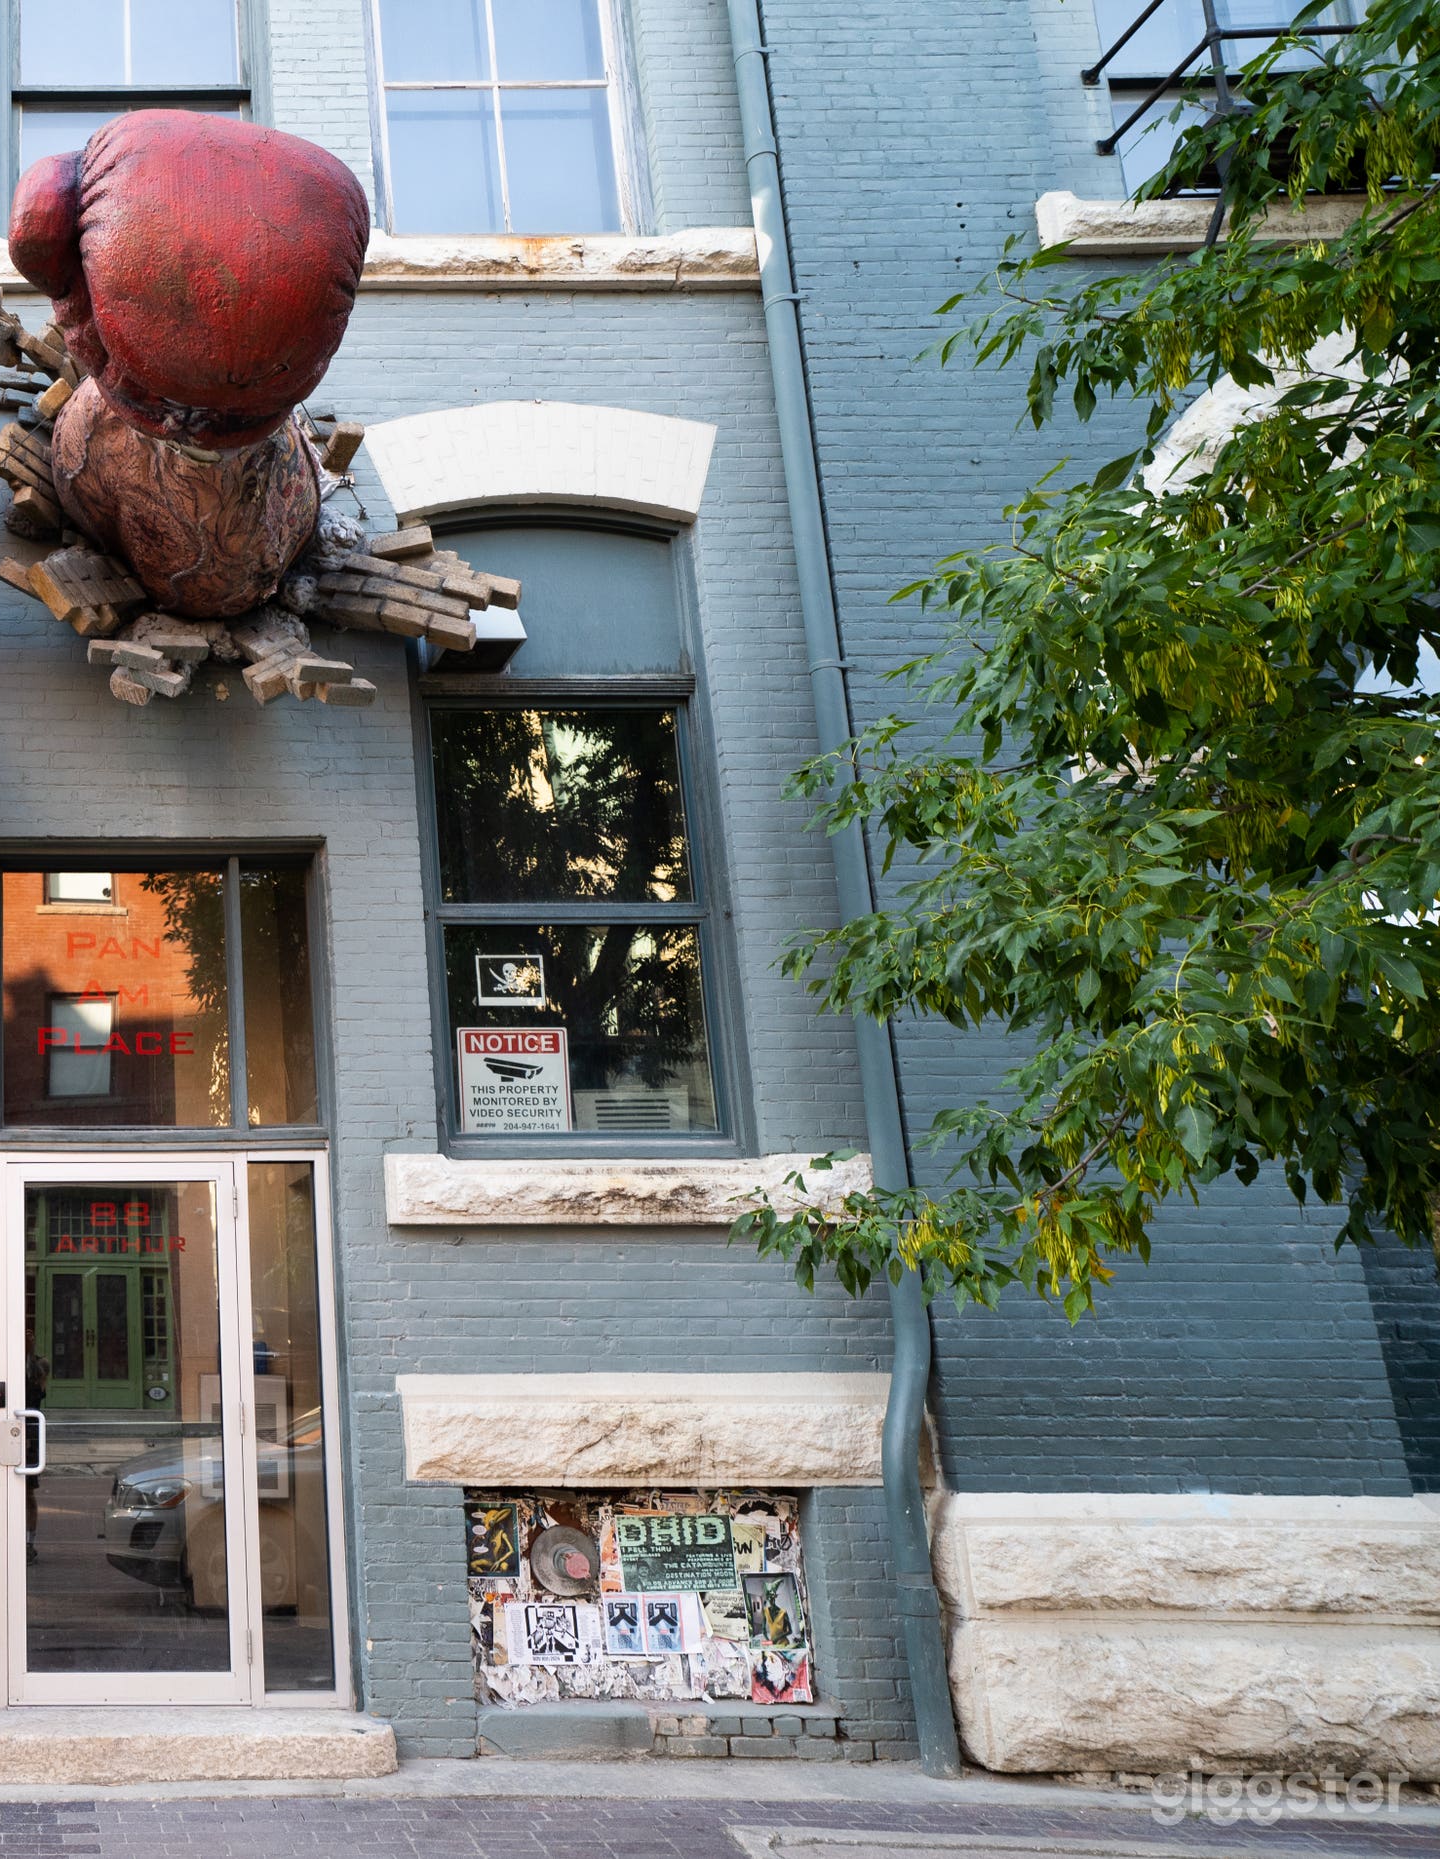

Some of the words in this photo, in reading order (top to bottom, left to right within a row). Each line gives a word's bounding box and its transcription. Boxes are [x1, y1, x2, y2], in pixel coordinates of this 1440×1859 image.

[66, 931, 161, 960] PAN
[37, 1027, 195, 1056] PLACE
[470, 1034, 555, 1052] NOTICE
[471, 1085, 496, 1094] THIS
[499, 1085, 559, 1094] PROPERTY
[473, 1097, 540, 1106] MONITORED
[543, 1097, 558, 1106] BY
[469, 1108, 504, 1118] VIDEO
[507, 1108, 562, 1118] SECURITY
[503, 1122, 560, 1131] 204-947-1641
[55, 1234, 187, 1254] ARTHUR
[617, 1516, 726, 1547] DHID
[665, 1571, 711, 1579] DESTINATION
